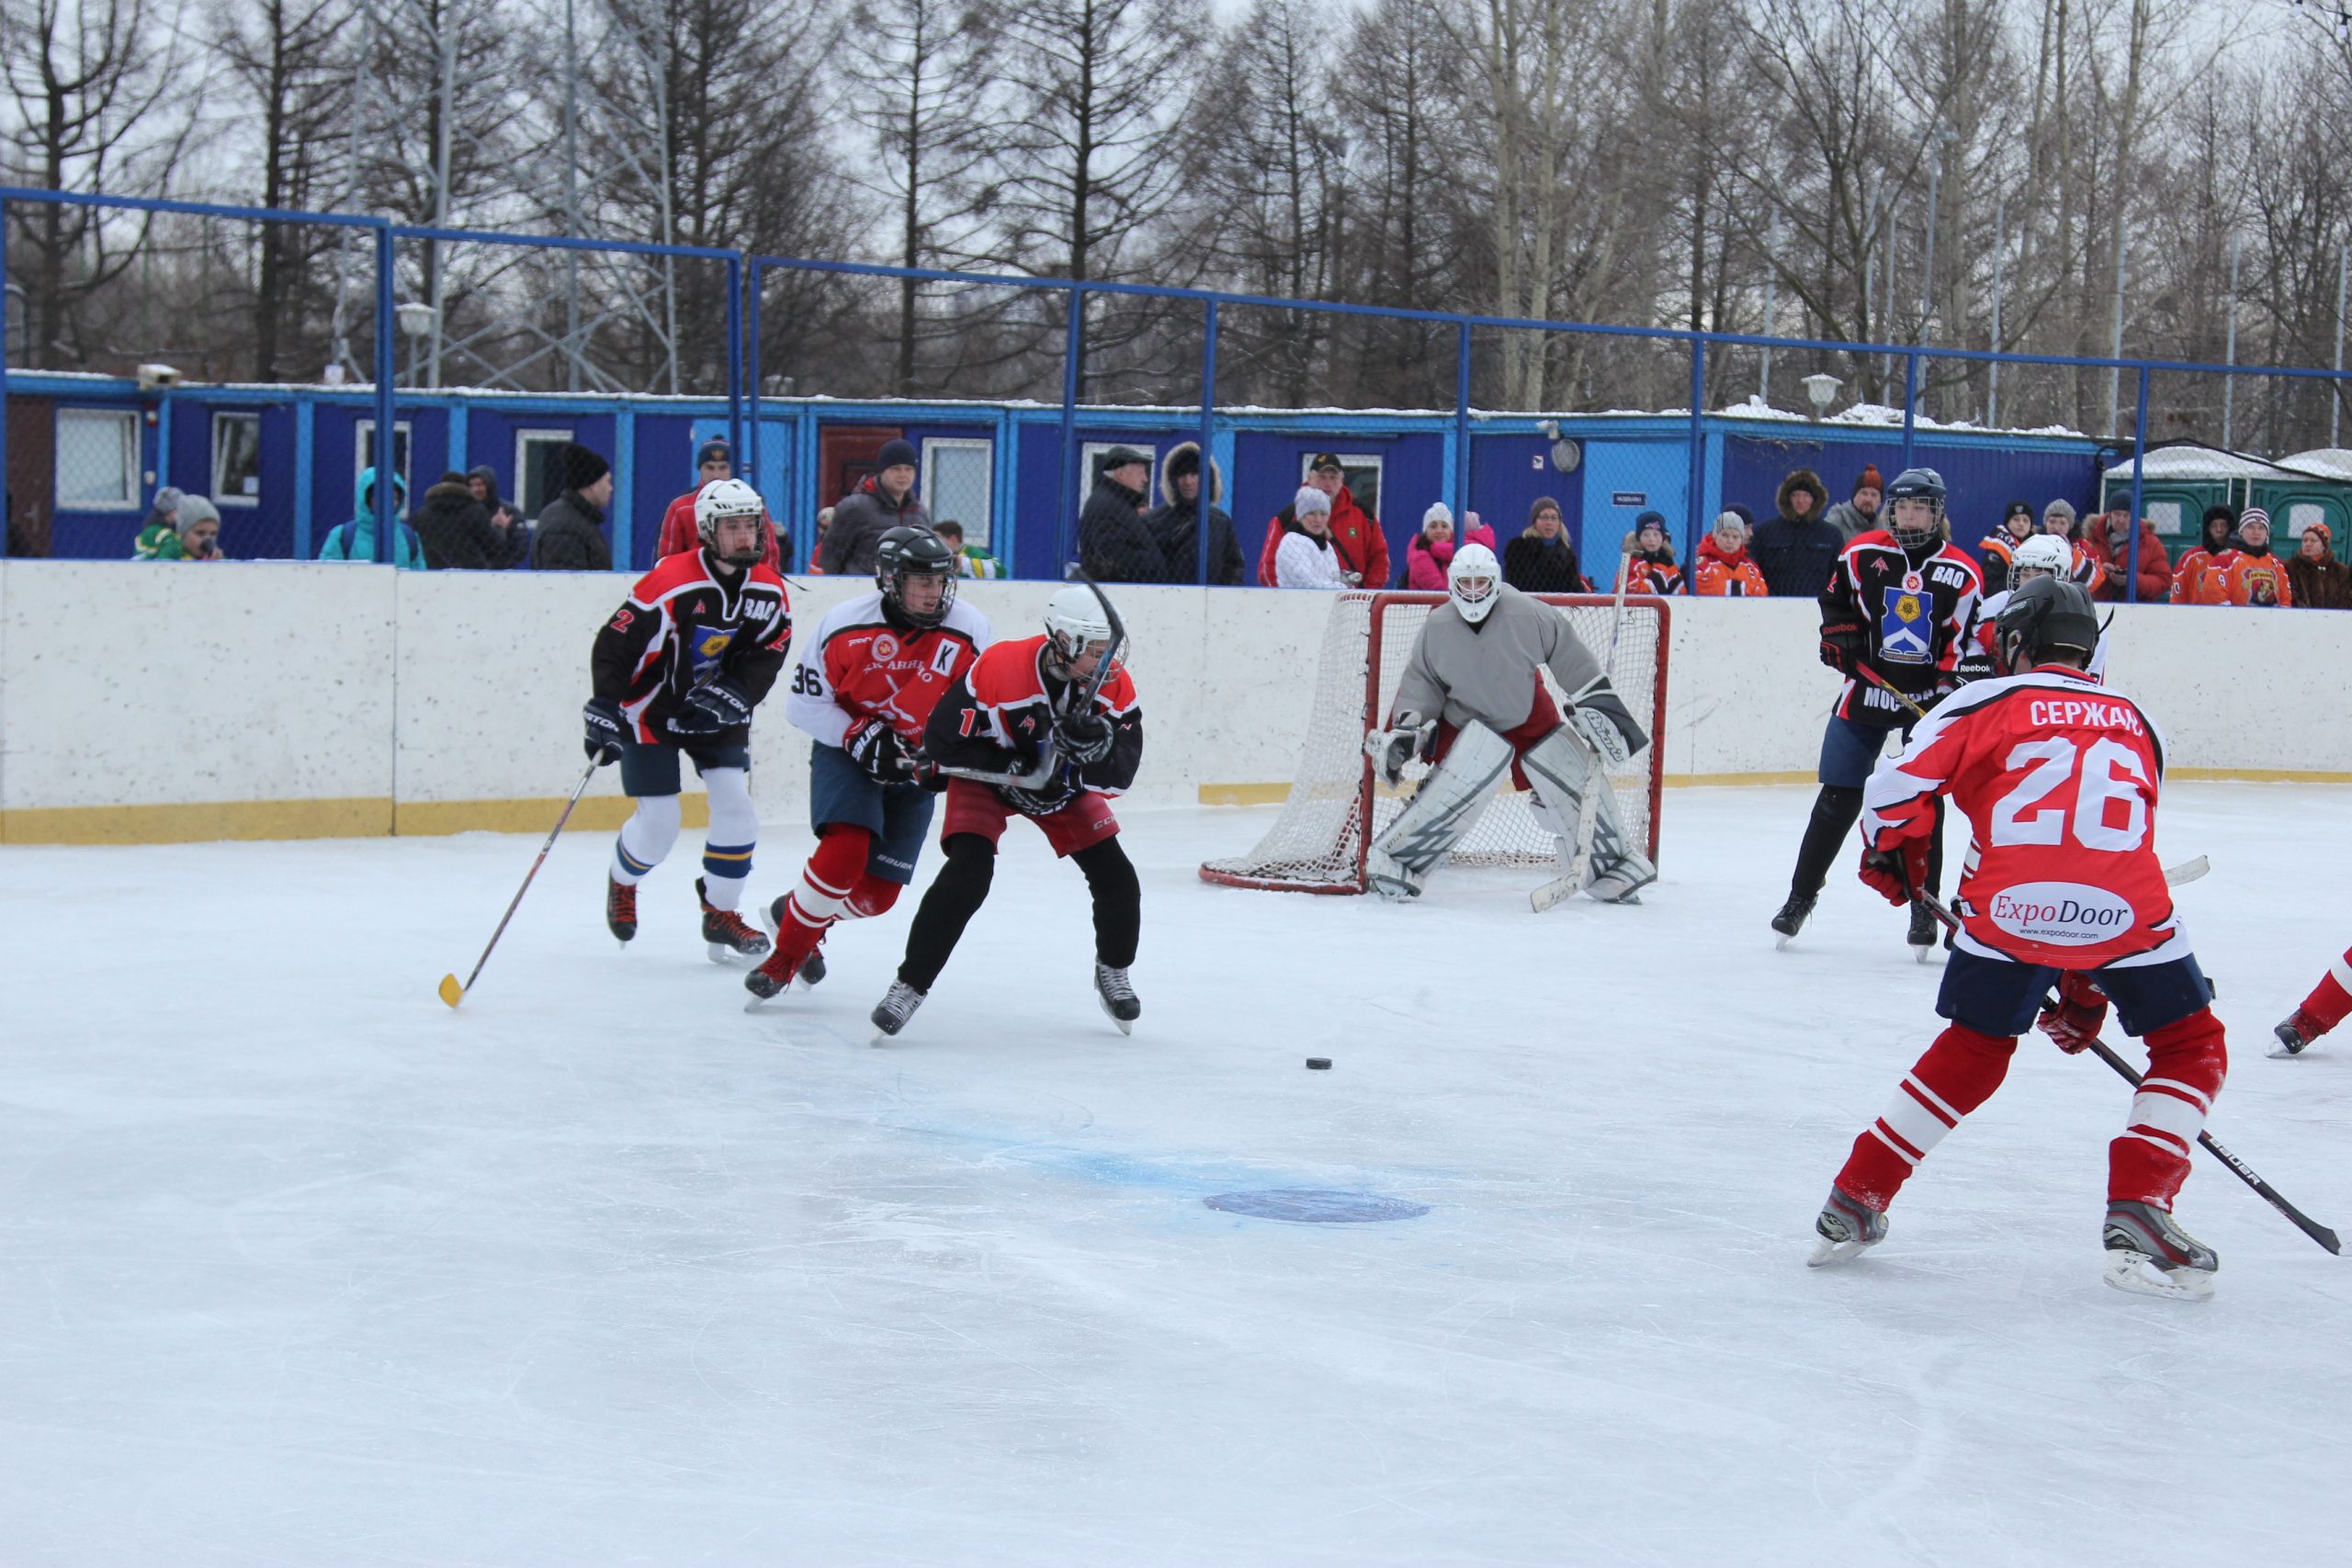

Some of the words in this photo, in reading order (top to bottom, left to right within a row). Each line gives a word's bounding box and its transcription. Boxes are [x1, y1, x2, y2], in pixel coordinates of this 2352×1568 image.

[1931, 566, 1965, 589] ВАО
[610, 609, 634, 634] 2
[1823, 623, 1859, 636] Reebok
[791, 662, 823, 697] 36
[1960, 663, 1992, 674] Reebok
[1990, 735, 2153, 852] 26
[1994, 896, 2129, 927] ExpoDoor
[2019, 928, 2098, 939] www.expodoor.com
[2209, 1138, 2262, 1186] BAUER
